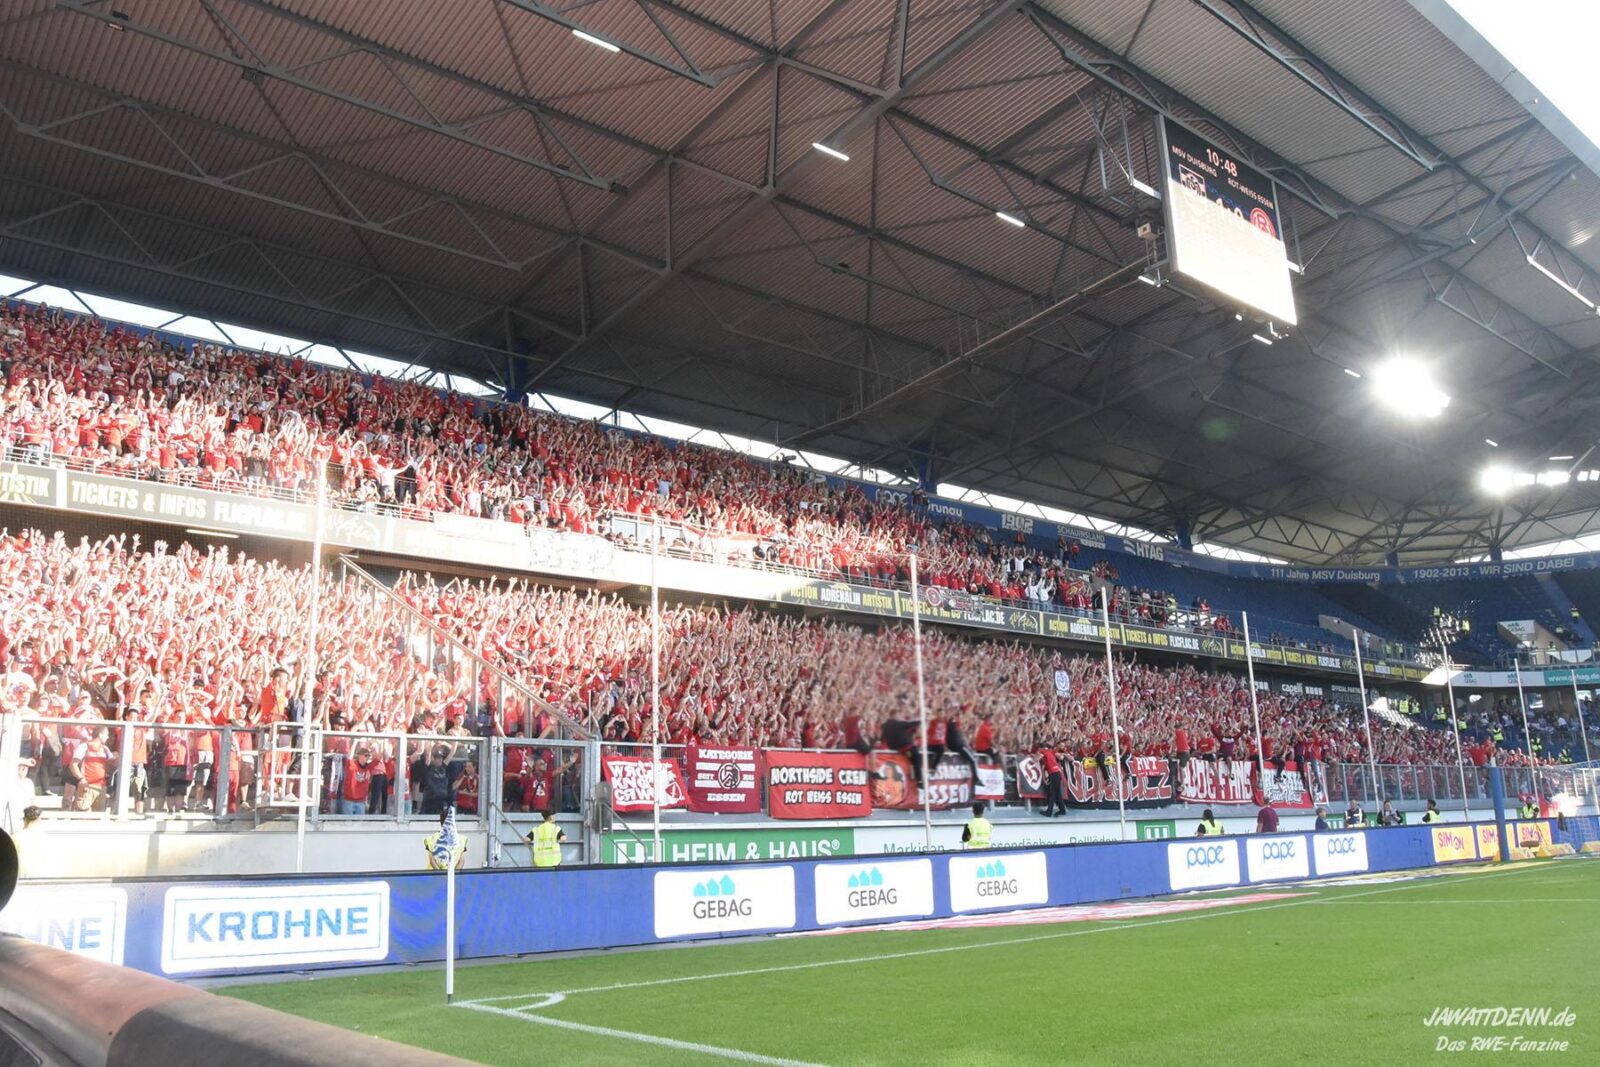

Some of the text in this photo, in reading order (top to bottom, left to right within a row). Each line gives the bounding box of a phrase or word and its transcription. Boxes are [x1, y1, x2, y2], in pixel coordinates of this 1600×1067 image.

[1172, 146, 1217, 177] MSV DUISBURG
[1206, 149, 1237, 177] 10:48
[1257, 194, 1274, 209] ESSEN
[72, 480, 139, 510] TICKETS
[143, 493, 156, 512] &
[160, 492, 207, 519] INFOS
[1056, 525, 1105, 542] SCHAUINSLAND
[1136, 542, 1165, 561] HTAG
[1271, 568, 1380, 581] 111 Jahre MSV Duisburg
[1414, 566, 1470, 579] 1902-2013
[1479, 565, 1501, 575] WIR
[1503, 562, 1533, 574] SIND
[1536, 557, 1575, 571] DABEI
[821, 587, 861, 606] ADRENALIN
[901, 597, 931, 616] TICETS
[1126, 629, 1147, 644] TICKETS
[1153, 633, 1168, 647] INFOS
[1169, 635, 1200, 651] FLICFLAC.DE
[698, 748, 754, 760] KATEGORIE
[770, 766, 833, 785] NORTHSIDE
[707, 792, 746, 803] ESSEN
[785, 790, 862, 805] ROT WEISS ESSEN
[1437, 831, 1465, 850] SIMON
[1482, 829, 1498, 844] SIM
[672, 841, 737, 862] HEIM
[745, 841, 760, 860] &
[1262, 840, 1296, 863] pape
[1327, 837, 1357, 857] pape
[1186, 845, 1225, 869] pape
[976, 879, 1018, 897] GEBAG
[847, 888, 897, 908] GEBAG
[692, 898, 752, 919] GEBAG
[187, 906, 369, 943] KROHNE
